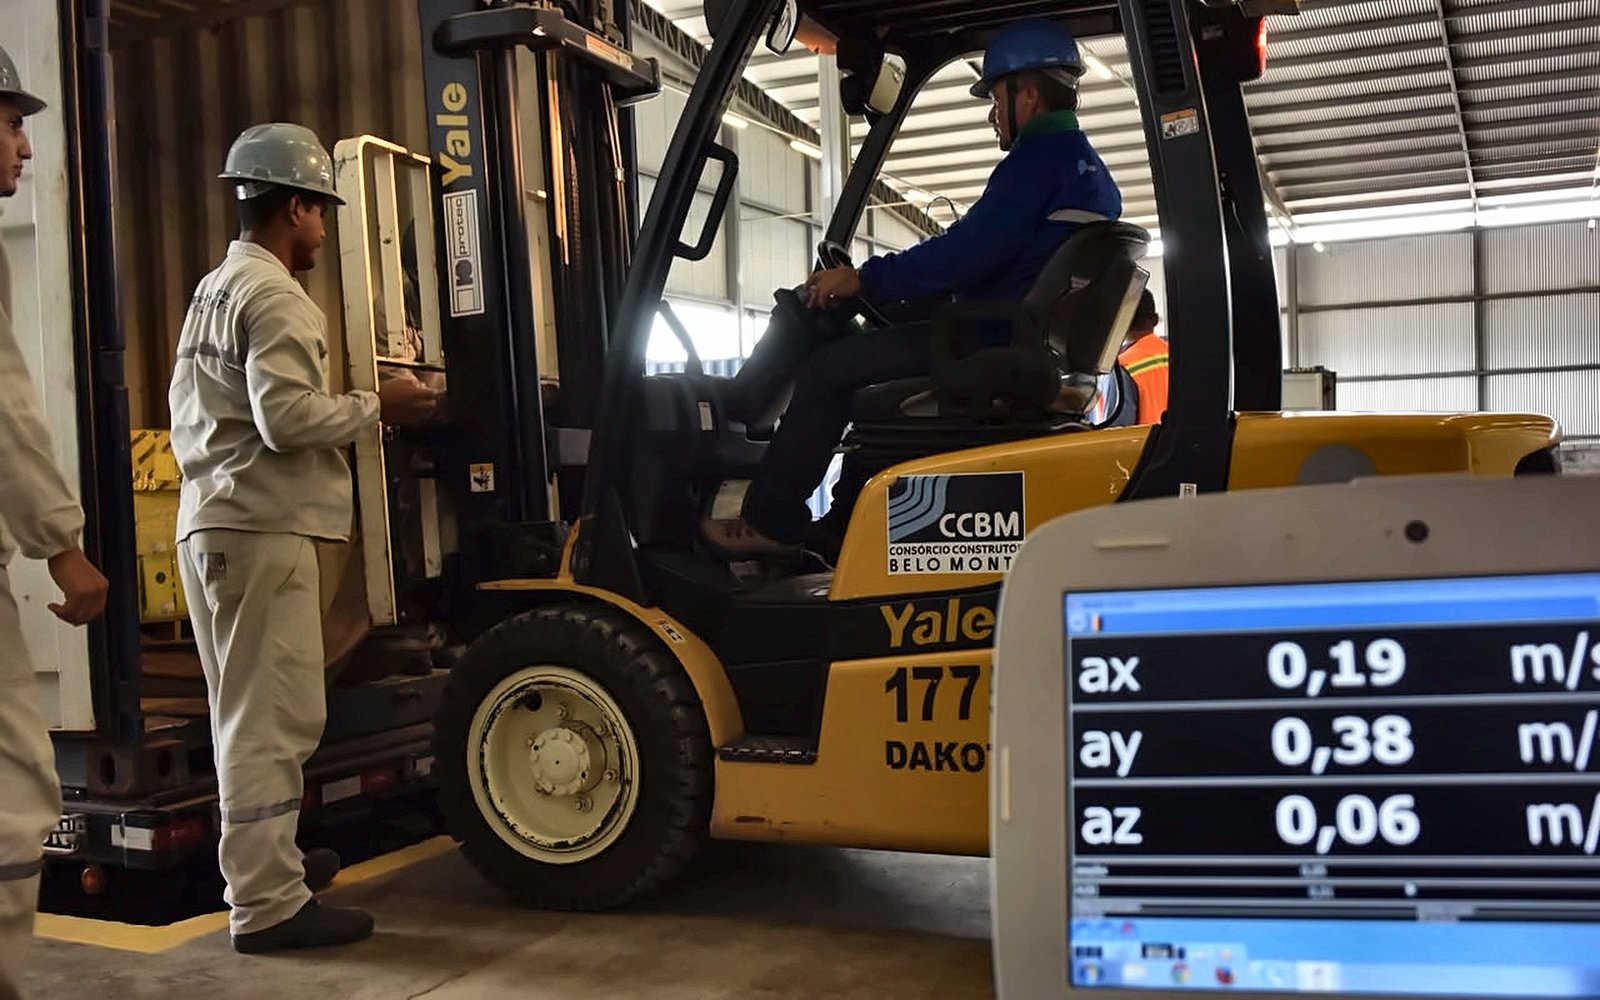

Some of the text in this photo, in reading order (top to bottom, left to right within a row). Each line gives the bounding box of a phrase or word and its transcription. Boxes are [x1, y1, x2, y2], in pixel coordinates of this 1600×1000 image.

[436, 82, 473, 186] Yale
[455, 197, 468, 256] protec
[889, 543, 950, 556] CONSÓRCIO
[939, 511, 1020, 538] CCBM
[889, 556, 1012, 573] BELO MONT
[880, 598, 995, 648] Yale
[885, 666, 993, 723] 177
[1079, 653, 1141, 694] ax
[1267, 639, 1407, 697] 0,19
[885, 741, 991, 773] DAKO
[1080, 710, 1600, 777] ay 0,38 m/
[1081, 804, 1143, 845] az
[1275, 794, 1421, 854] 0,06
